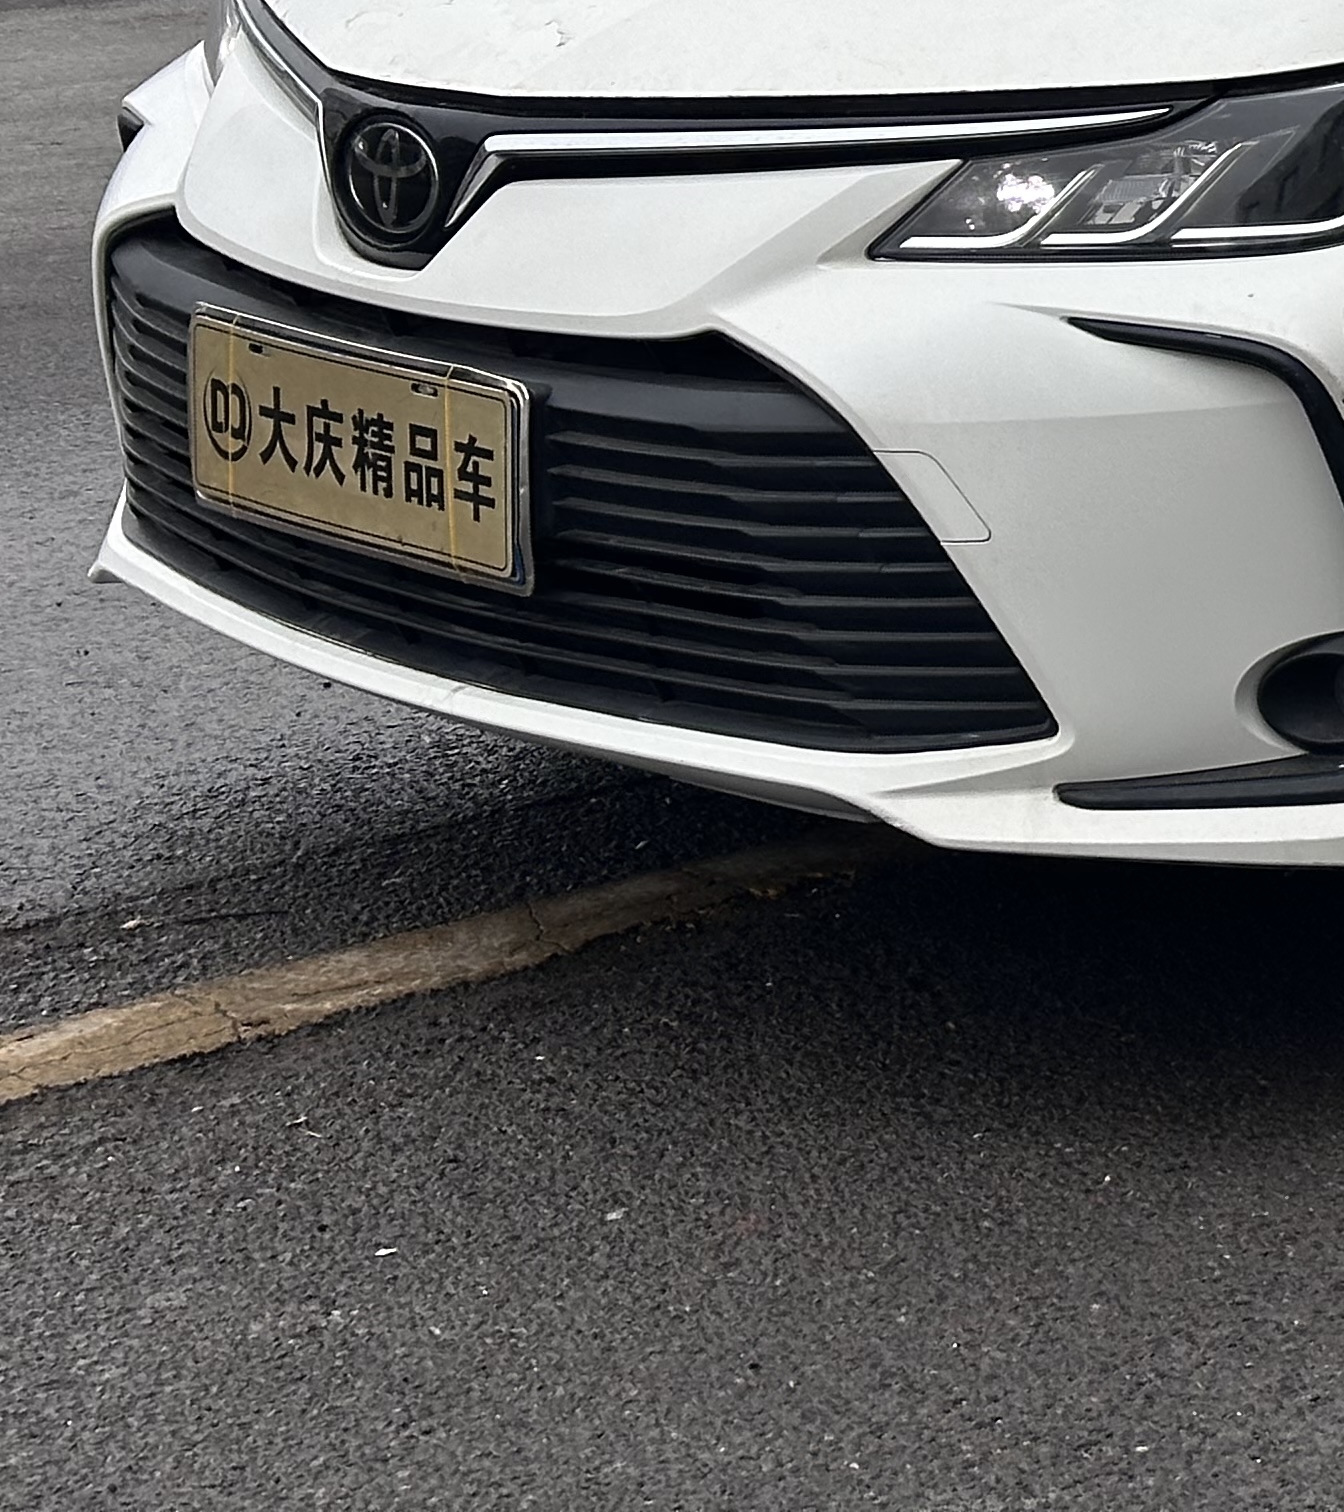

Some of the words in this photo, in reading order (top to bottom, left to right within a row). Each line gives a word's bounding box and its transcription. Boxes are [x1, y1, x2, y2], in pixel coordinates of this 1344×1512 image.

[258, 386, 496, 522] 大庆精品车
